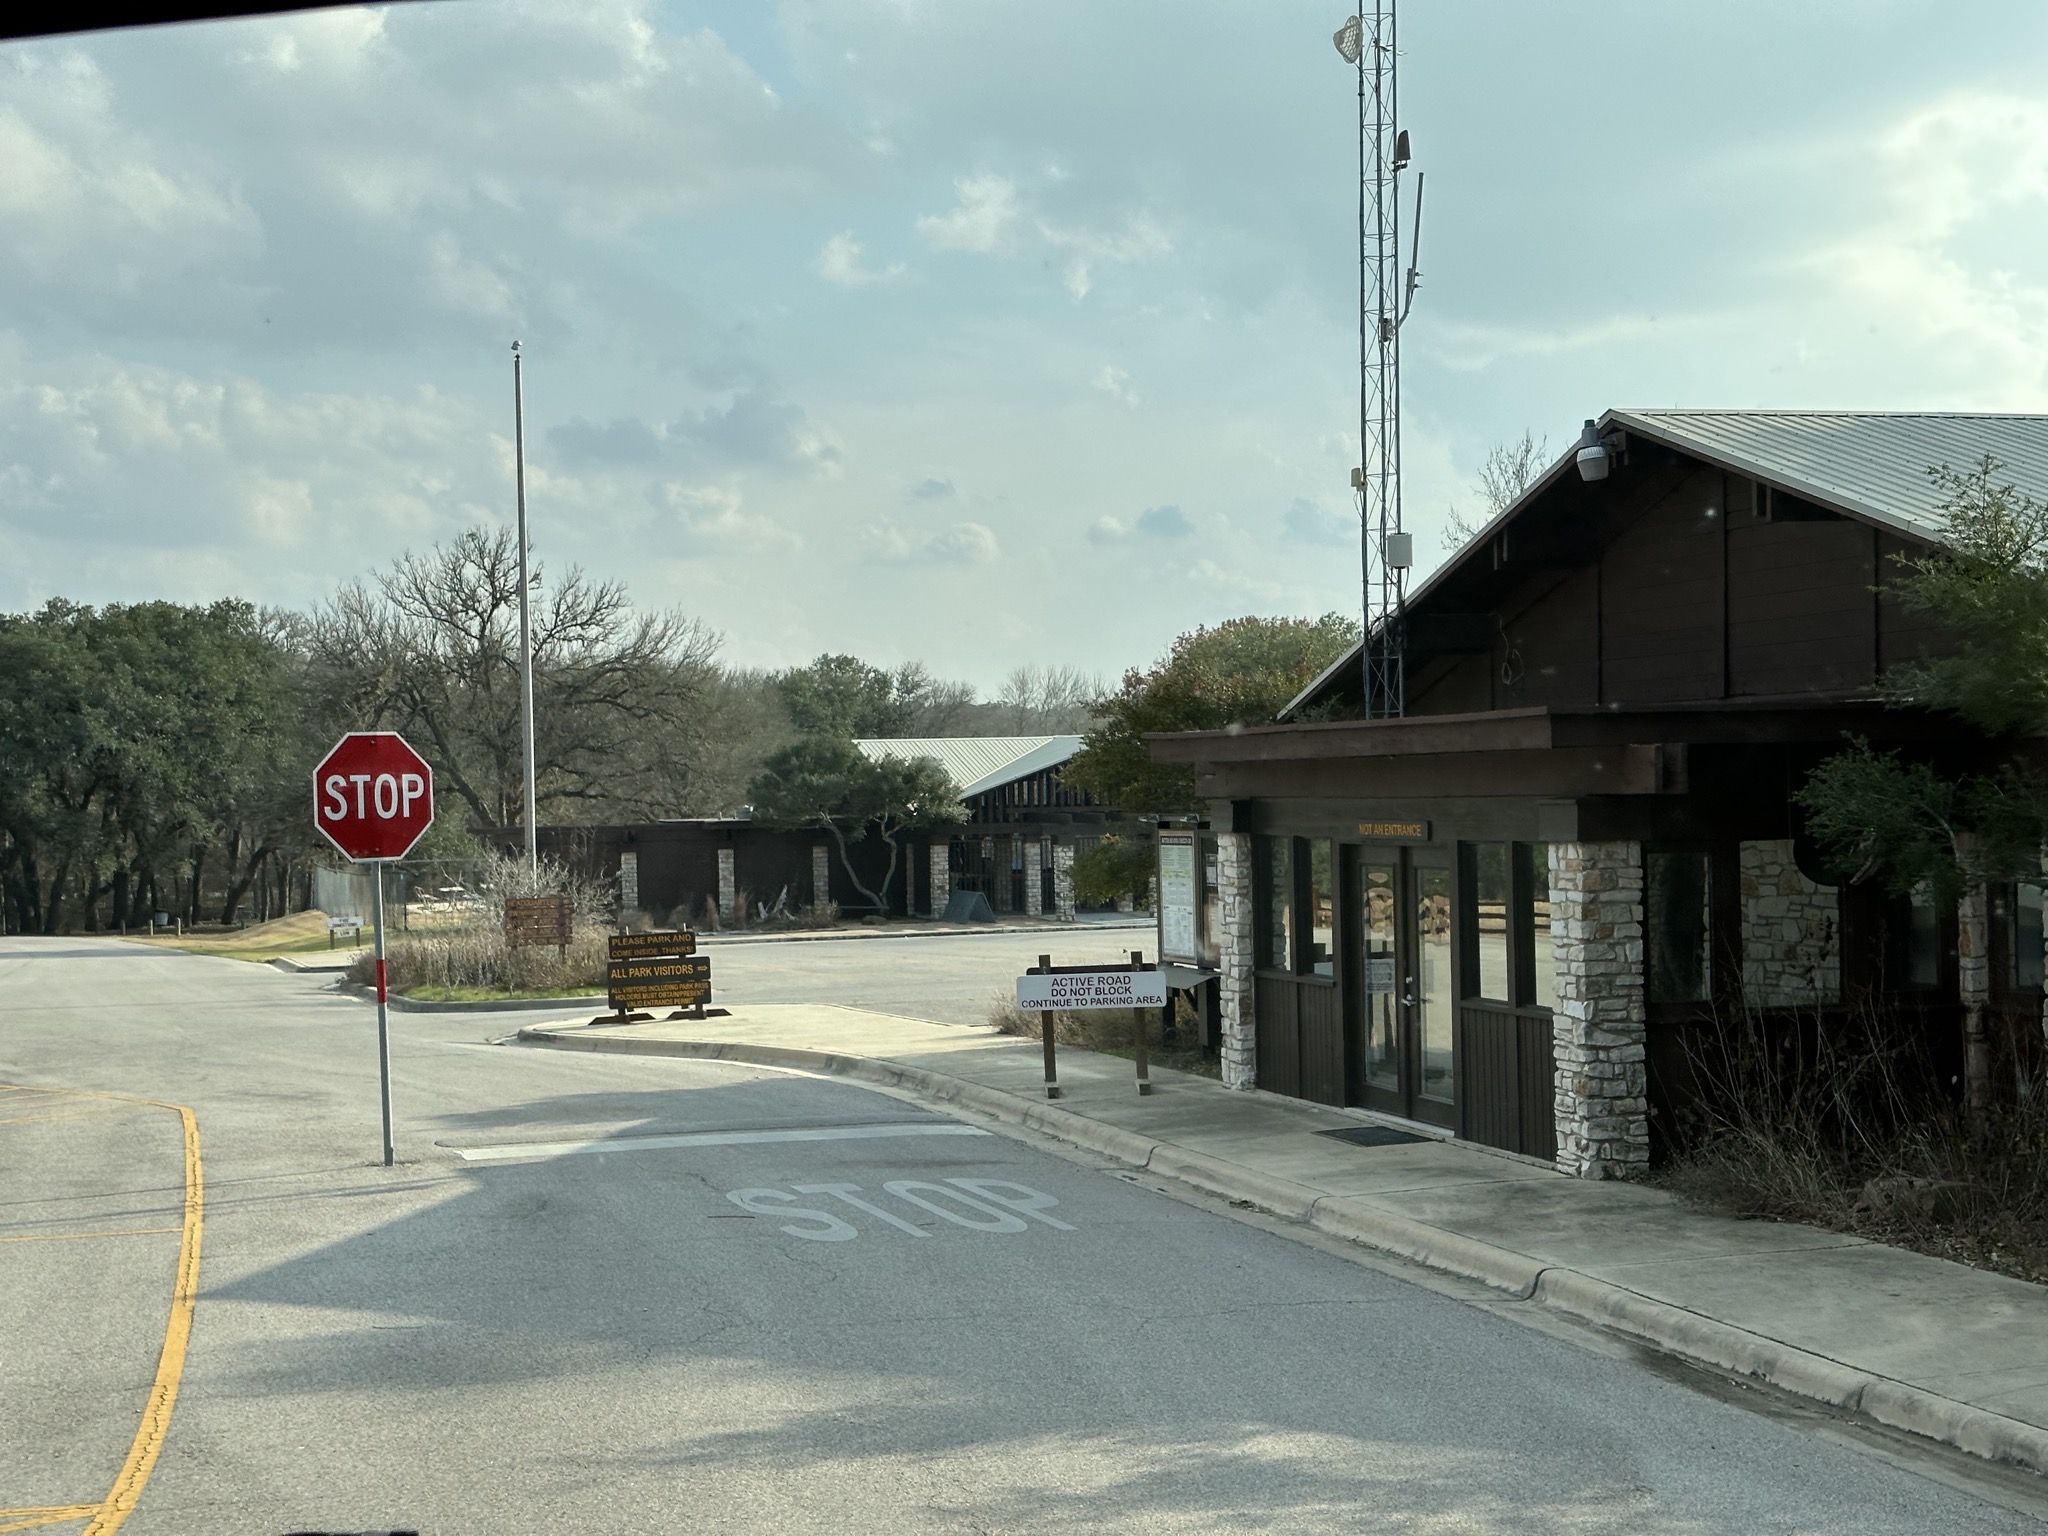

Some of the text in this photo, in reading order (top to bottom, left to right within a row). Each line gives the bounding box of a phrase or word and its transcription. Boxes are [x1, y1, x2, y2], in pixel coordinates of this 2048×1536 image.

[324, 774, 424, 821] STOP
[1358, 823, 1422, 836] NOT AN ENTRANCE
[612, 934, 691, 946] PLEASE PARK AND
[612, 949, 633, 957] COME
[662, 946, 693, 954] THANKS!
[611, 964, 694, 978] ALL PARK VISITORS
[1052, 976, 1131, 987] ACTIVE ROAD
[1051, 986, 1132, 997] DO NOT BLOCK
[644, 998, 673, 1006] ENTRANCE
[1021, 995, 1162, 1008] CONTINUE TO PARKING AREA
[725, 1178, 1078, 1242] STOP
